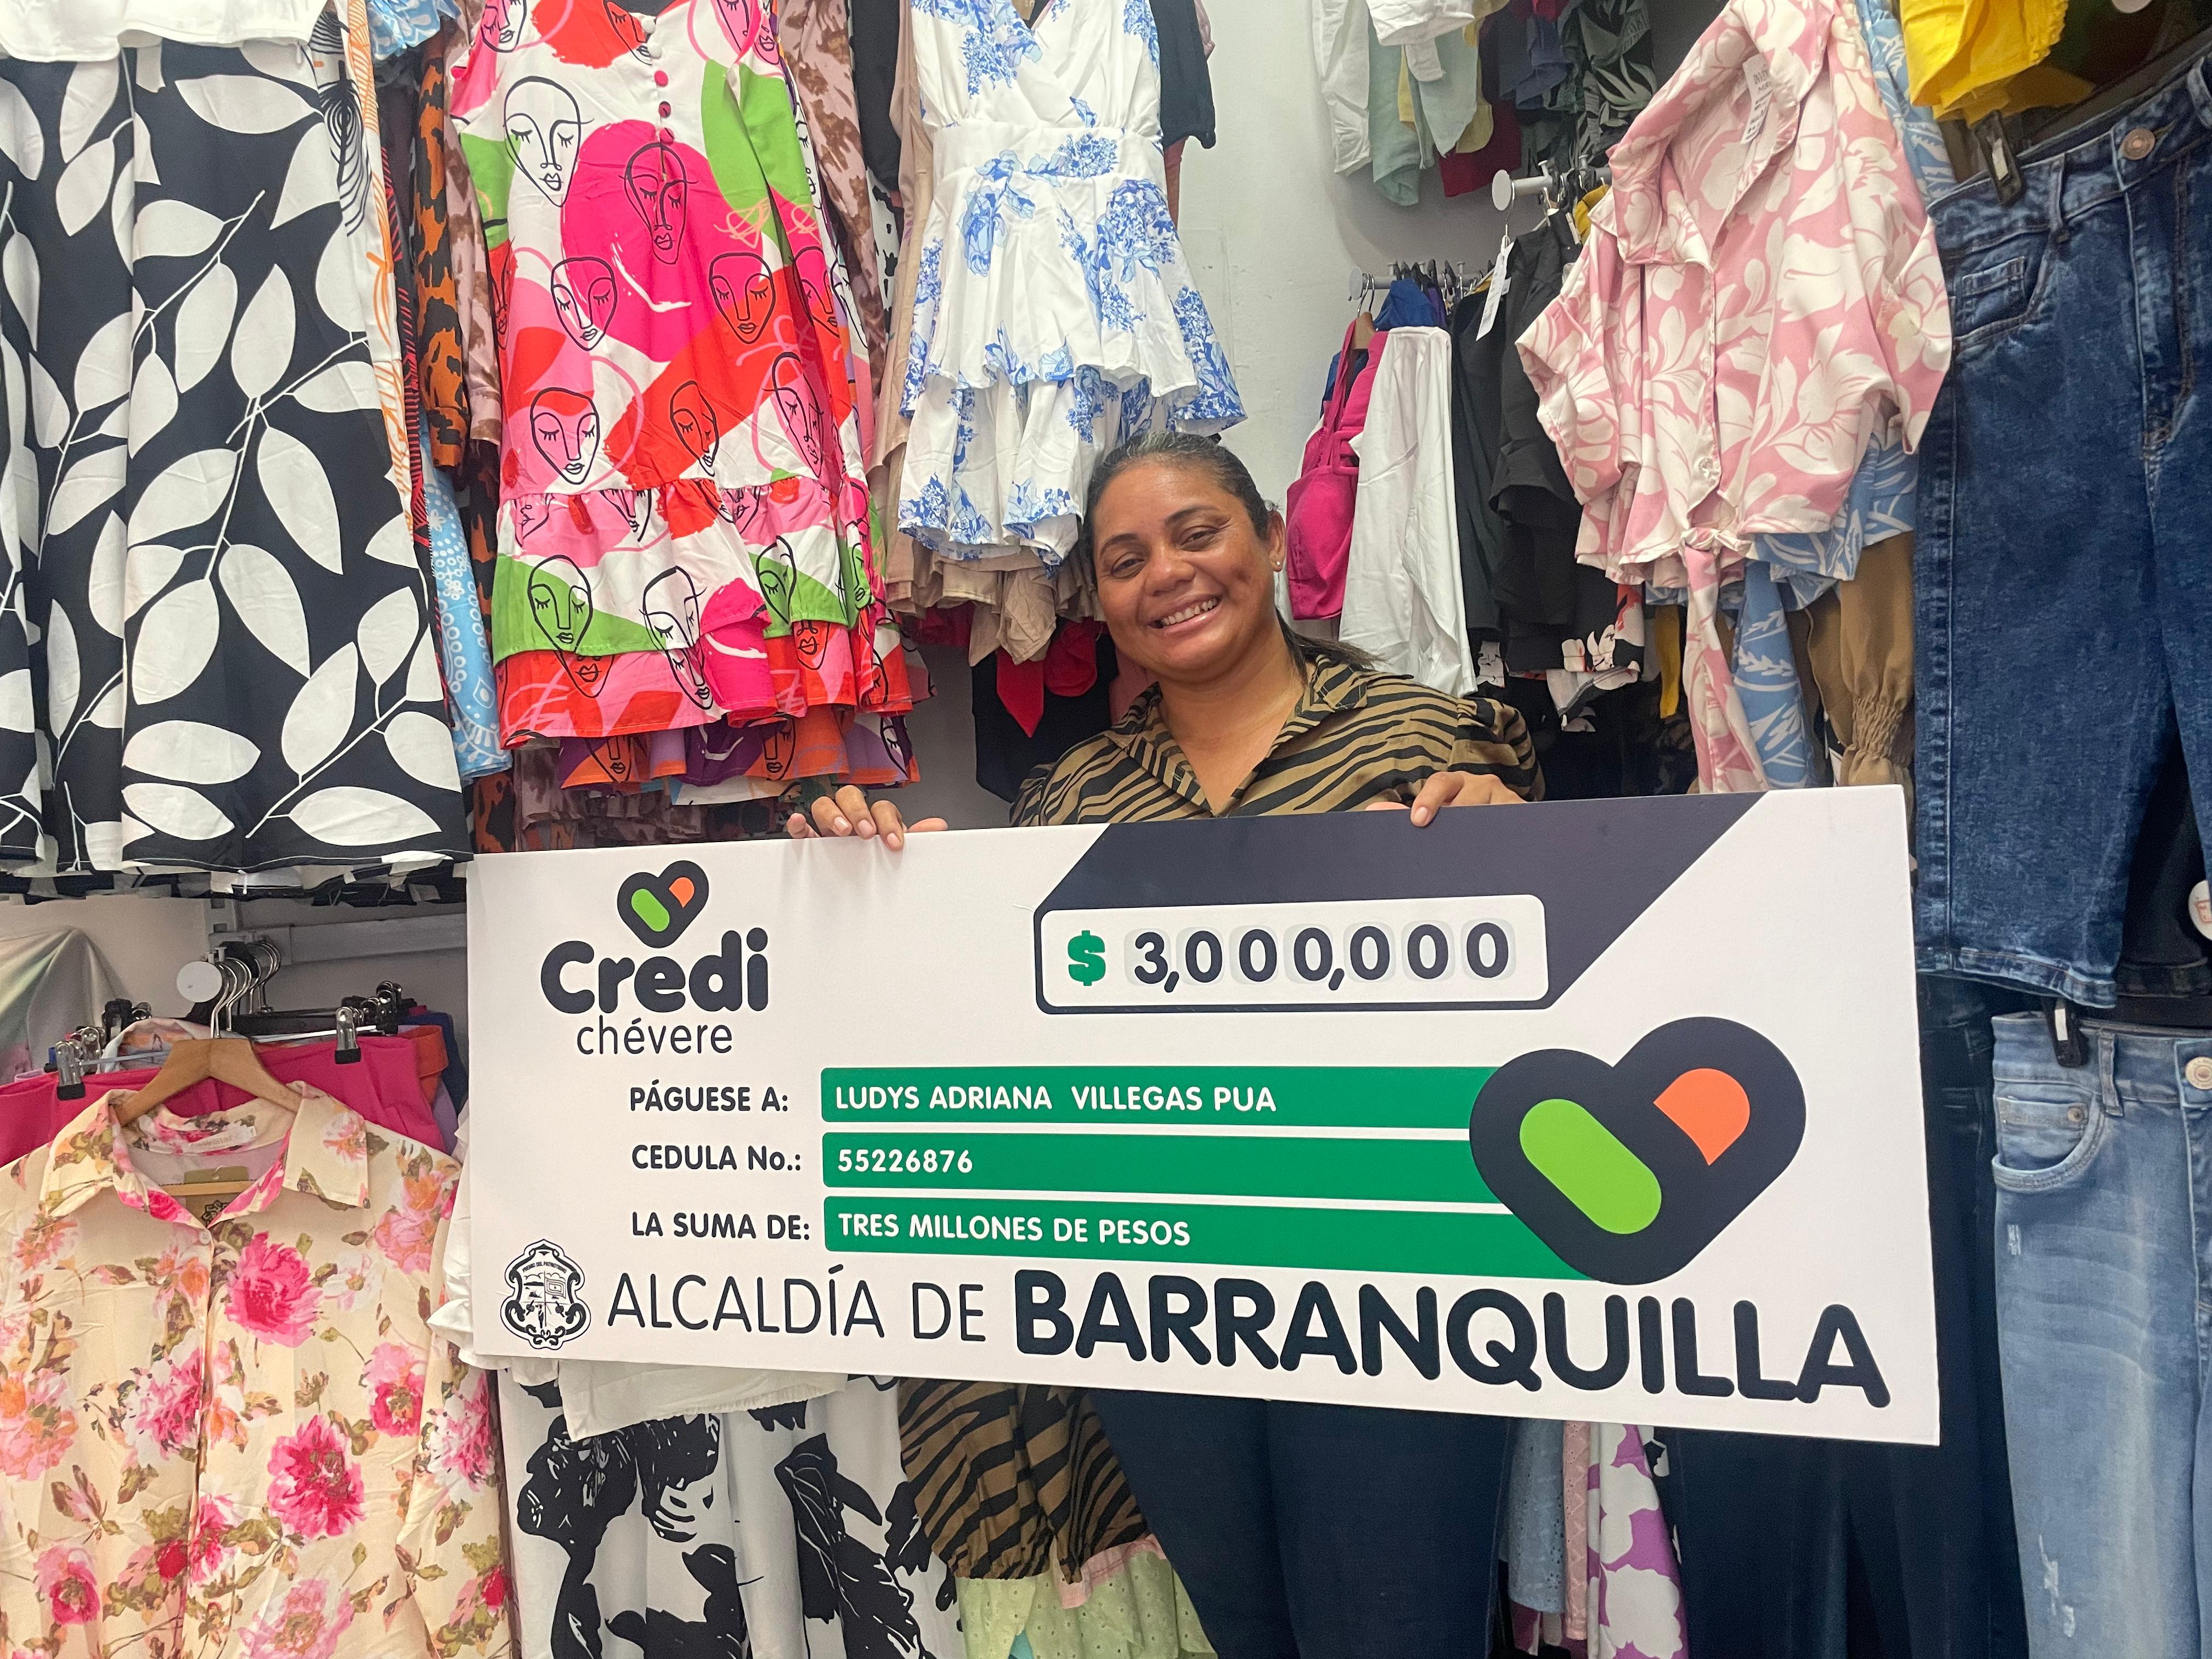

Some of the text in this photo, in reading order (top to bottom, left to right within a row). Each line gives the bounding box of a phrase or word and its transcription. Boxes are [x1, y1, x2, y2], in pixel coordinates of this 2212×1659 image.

[540, 927, 769, 1015] Credi
[1068, 922, 1509, 993] $ 3,000,000
[577, 1014, 732, 1055] chévere
[630, 1079, 788, 1111] PÁGUESE A:
[836, 1086, 1277, 1111] LUDYS ADRIANA VILLEGAS PUA
[632, 1144, 801, 1171] CEDULA No.:
[838, 1149, 973, 1173] 55226876
[632, 1211, 810, 1240] LA SUMA DE:
[838, 1213, 1190, 1246] TRES MILLONES DE PESOS
[607, 1263, 1891, 1409] ALCALDÍA DE BARRANQUILLA
